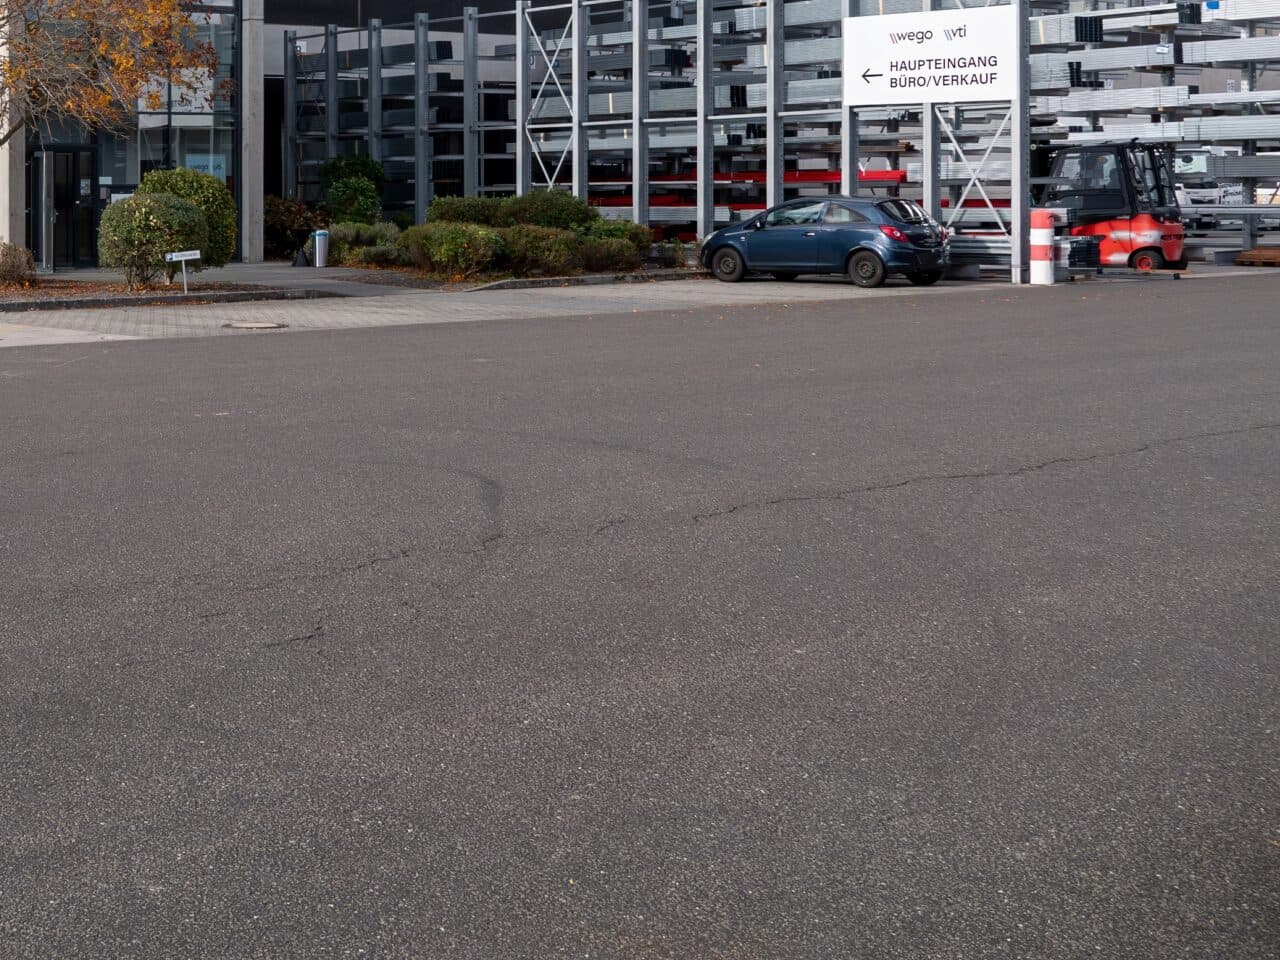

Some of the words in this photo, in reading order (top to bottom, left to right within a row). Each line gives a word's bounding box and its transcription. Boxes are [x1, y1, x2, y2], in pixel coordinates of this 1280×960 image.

[896, 29, 934, 44] wego
[951, 24, 967, 39] vti
[889, 55, 998, 72] HAUPTEINGANG
[889, 72, 998, 89] BÜRO/VERKAUF
